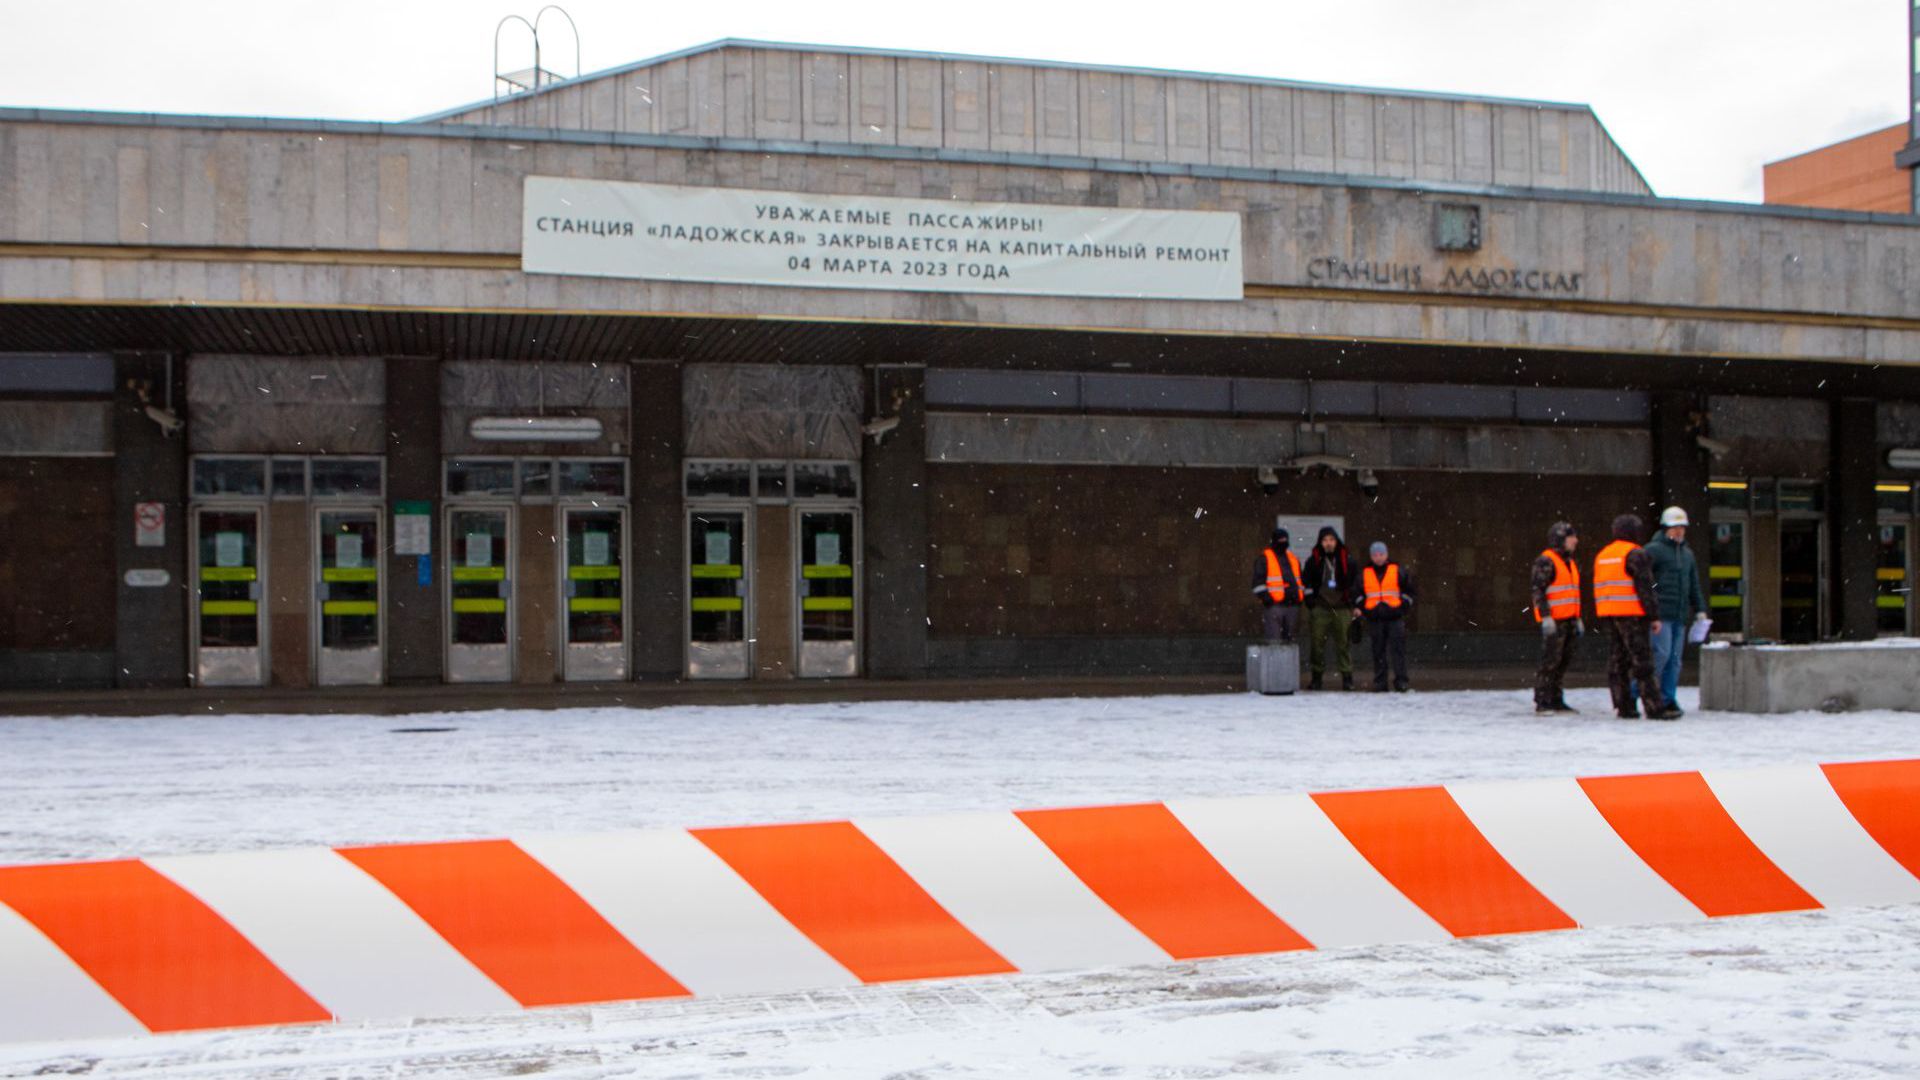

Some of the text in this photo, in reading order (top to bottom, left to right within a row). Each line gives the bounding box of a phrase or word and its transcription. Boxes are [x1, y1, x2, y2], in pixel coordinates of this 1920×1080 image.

[755, 205, 1043, 232] УВАЖАЕМЫЕ ПАССАЖИРЫ!
[536, 216, 1230, 262] СТАНЦИЯ «ЛАДОЖСКАЯ» ЗАКРЫВАЕТСЯ НА КАПИТАЛЬНЫЙ РЕМОНТ
[788, 255, 1010, 280] 04 МАРТА 2023 ГОДА
